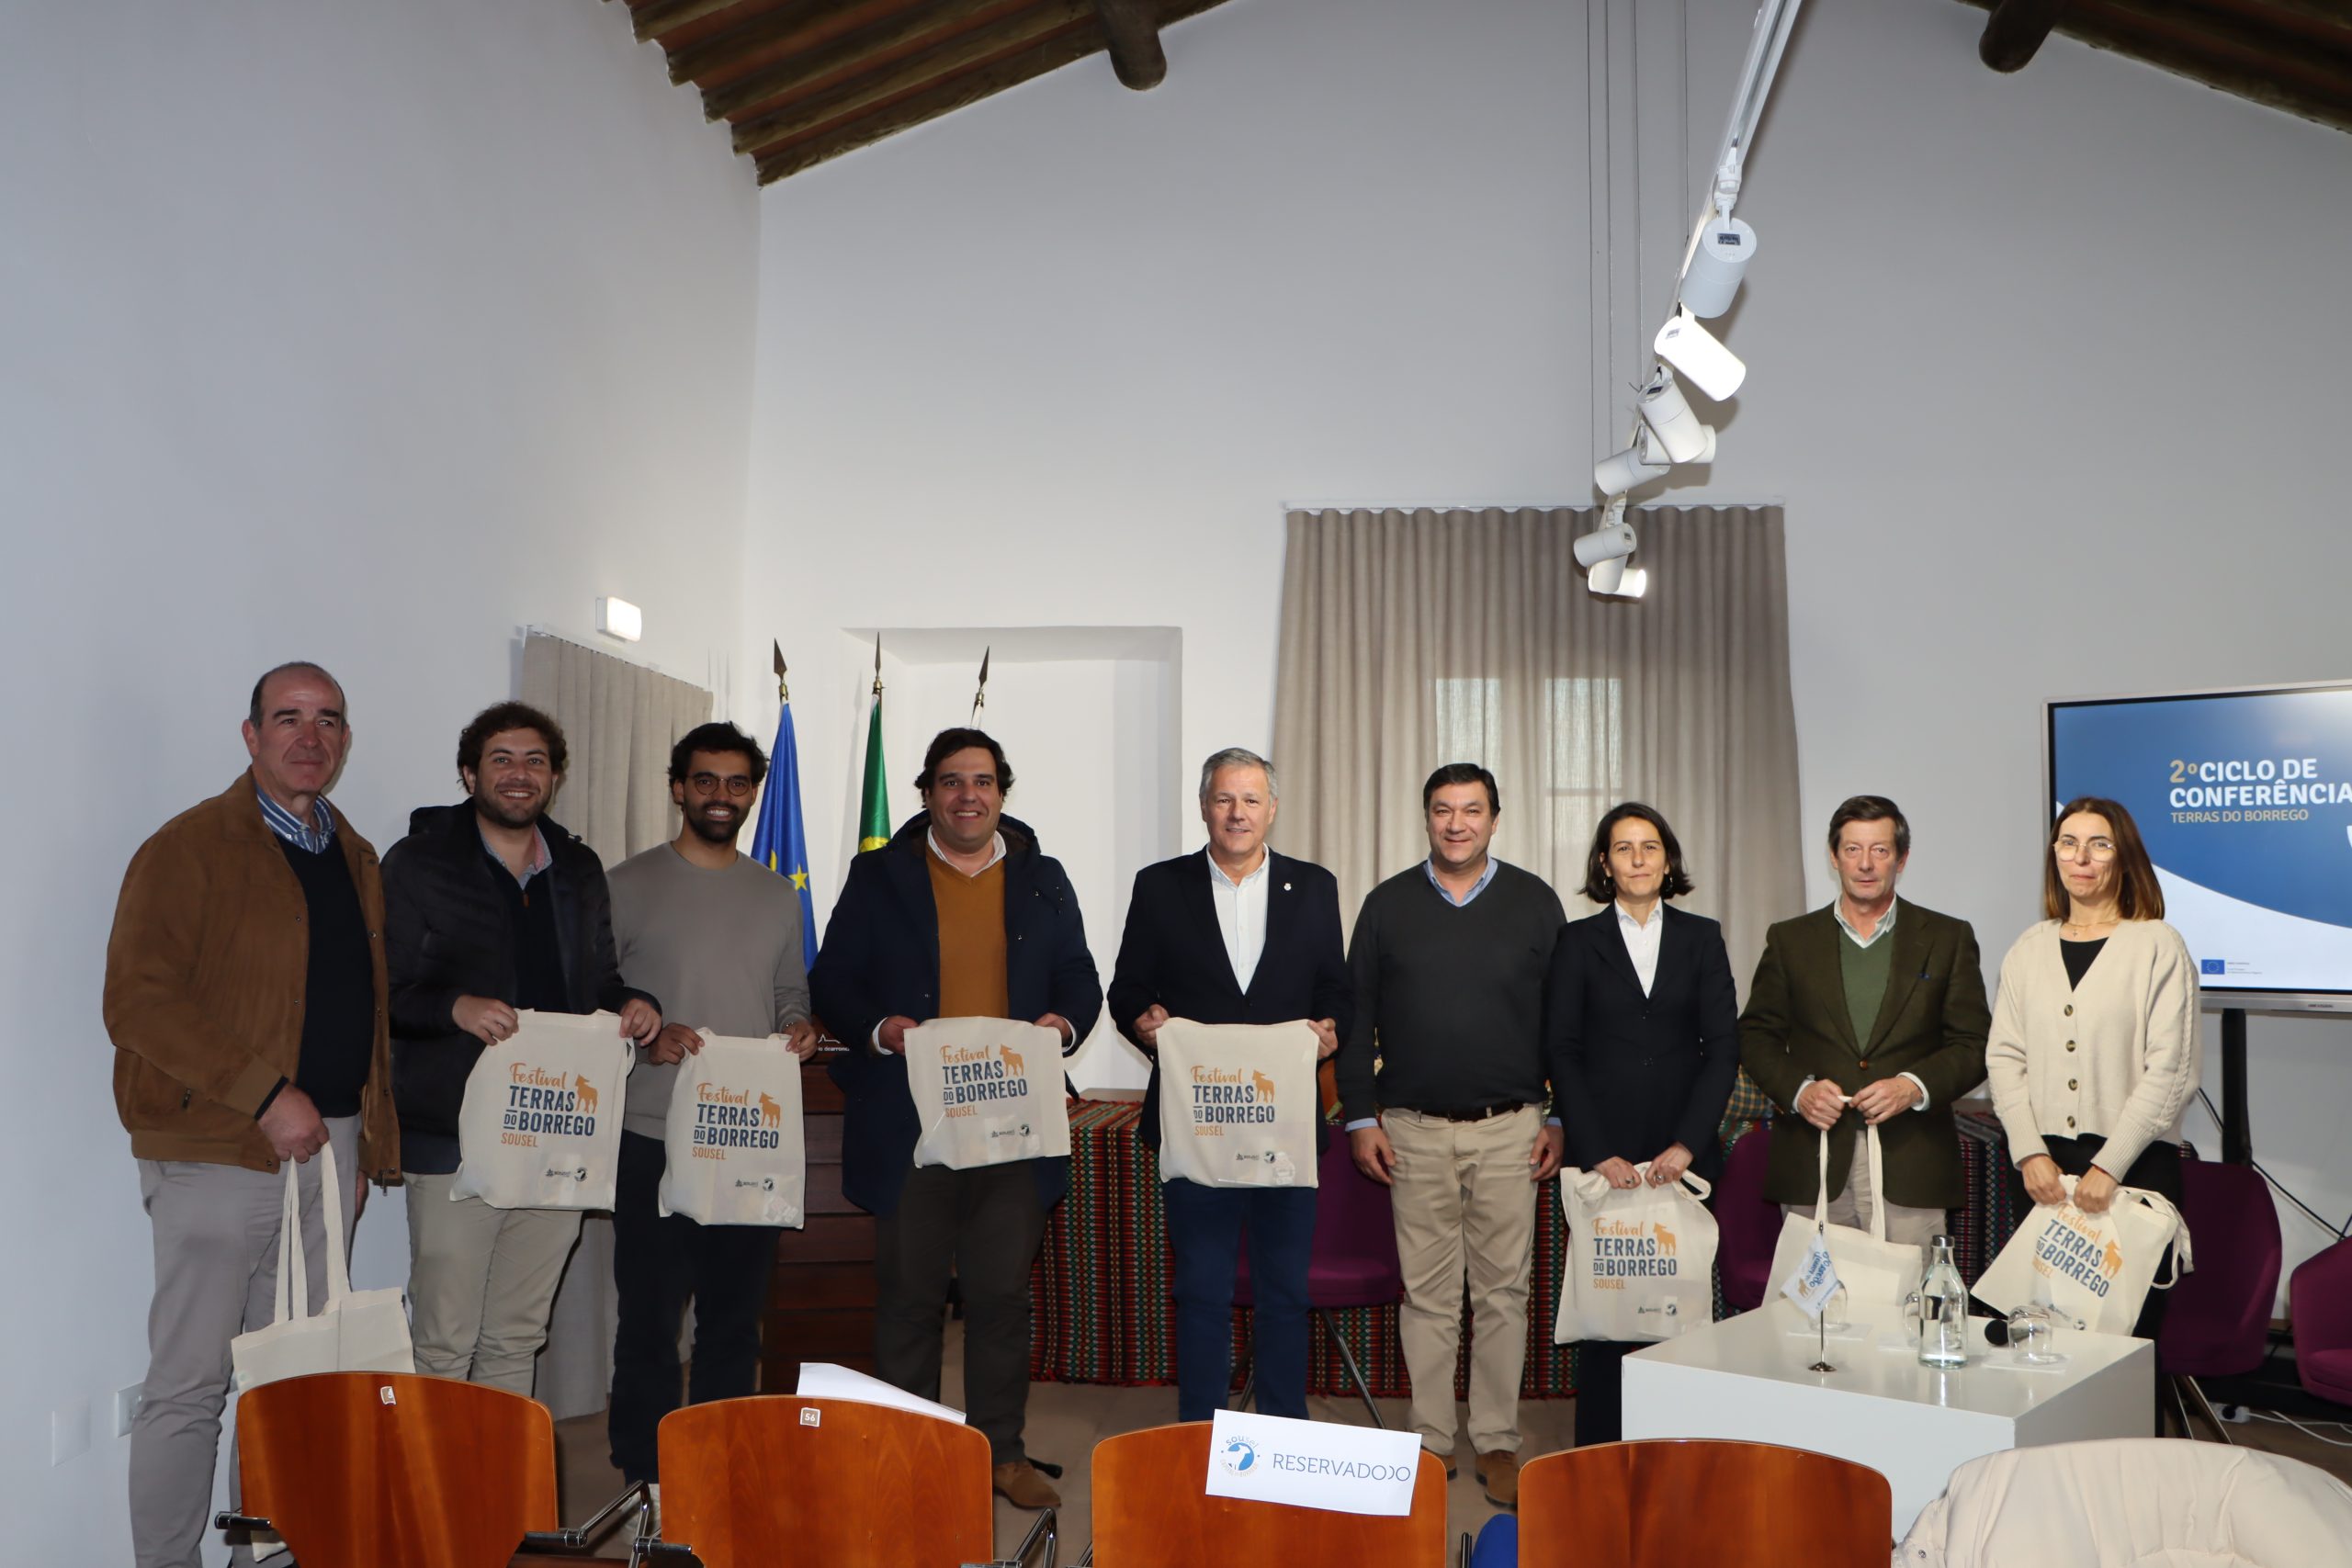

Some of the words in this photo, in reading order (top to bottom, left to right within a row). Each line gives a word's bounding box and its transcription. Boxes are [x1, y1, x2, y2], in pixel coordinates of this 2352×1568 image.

[2199, 760, 2276, 783] CICLO
[2282, 758, 2318, 780] DE
[2170, 810, 2220, 824] TERRAS
[2222, 810, 2242, 823] DO
[2245, 808, 2309, 822] BORREGO
[940, 1044, 991, 1064] Festival
[509, 1062, 567, 1089] Festival
[942, 1060, 1004, 1085] TERRAS
[1190, 1065, 1244, 1085] Festival
[509, 1085, 576, 1112] TERRAS
[696, 1082, 750, 1106] Festival
[943, 1090, 954, 1101] DO
[956, 1078, 1028, 1104] BORREGO
[1193, 1085, 1254, 1104] TERRAS
[696, 1103, 760, 1127] TERRAS
[944, 1105, 978, 1118] SOUSEL
[1204, 1105, 1275, 1123] BORREGO
[503, 1112, 517, 1126] DO
[518, 1111, 595, 1136] BORREGO
[1194, 1124, 1225, 1136] SOUSEL
[501, 1132, 539, 1148] SOUSEL
[694, 1129, 706, 1141] DO
[707, 1126, 779, 1149] BORREGO
[692, 1146, 727, 1160] SOUSEL
[1591, 1216, 1645, 1237] Festival
[2057, 1201, 2102, 1244] Festival
[1593, 1237, 1656, 1257] TERRAS
[2044, 1218, 2103, 1268] TERRAS
[1593, 1262, 1604, 1272] DO
[1606, 1258, 1678, 1277] BORREGO
[2041, 1243, 2109, 1298] BORREGO
[1593, 1278, 1625, 1290] SOUSEL
[804, 1412, 816, 1422] 56
